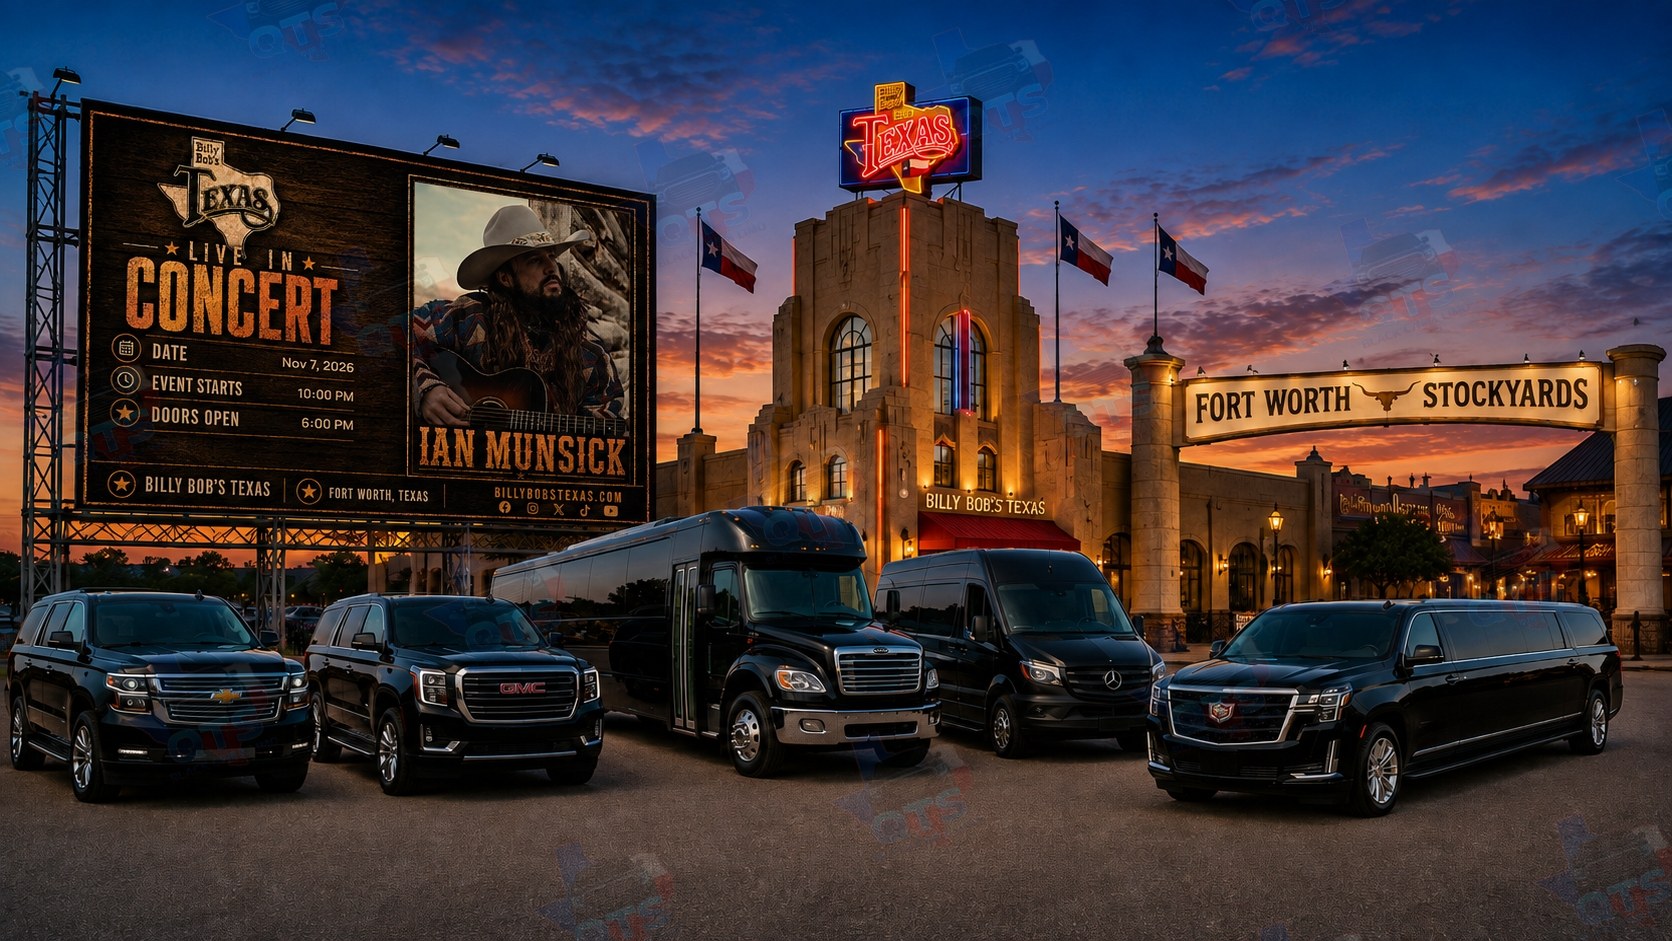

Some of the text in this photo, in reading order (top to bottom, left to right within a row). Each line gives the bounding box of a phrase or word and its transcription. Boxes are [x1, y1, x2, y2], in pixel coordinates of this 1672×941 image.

[195, 142, 220, 158] Billy
[853, 114, 953, 178] TEXAS
[195, 153, 220, 166] Bob's
[174, 165, 276, 229] TEXAS
[188, 240, 293, 272] LIVE IN
[125, 256, 339, 346] CONCERT
[152, 343, 188, 361] DATE
[282, 356, 355, 373] Nov 7, 2026
[152, 375, 243, 397] EVENT STARTS
[298, 388, 354, 402] 10:00 PM
[1195, 390, 1256, 424] FORT
[1264, 385, 1351, 416] WORTH
[1423, 377, 1589, 410] STOCKYARDS
[152, 406, 239, 427] DOORS OPEN
[301, 417, 354, 431] 6:00 PM
[419, 426, 626, 476] IAN MUNSICK
[145, 475, 271, 497] BILLY BOB'S TEXAS
[329, 487, 429, 503] FORT WORTH, TEXAS
[494, 486, 622, 503] BILLYBOBSTEXAS.COM
[926, 493, 1046, 515] BILLY BOB'S TEXAS
[500, 682, 546, 694] GMC
